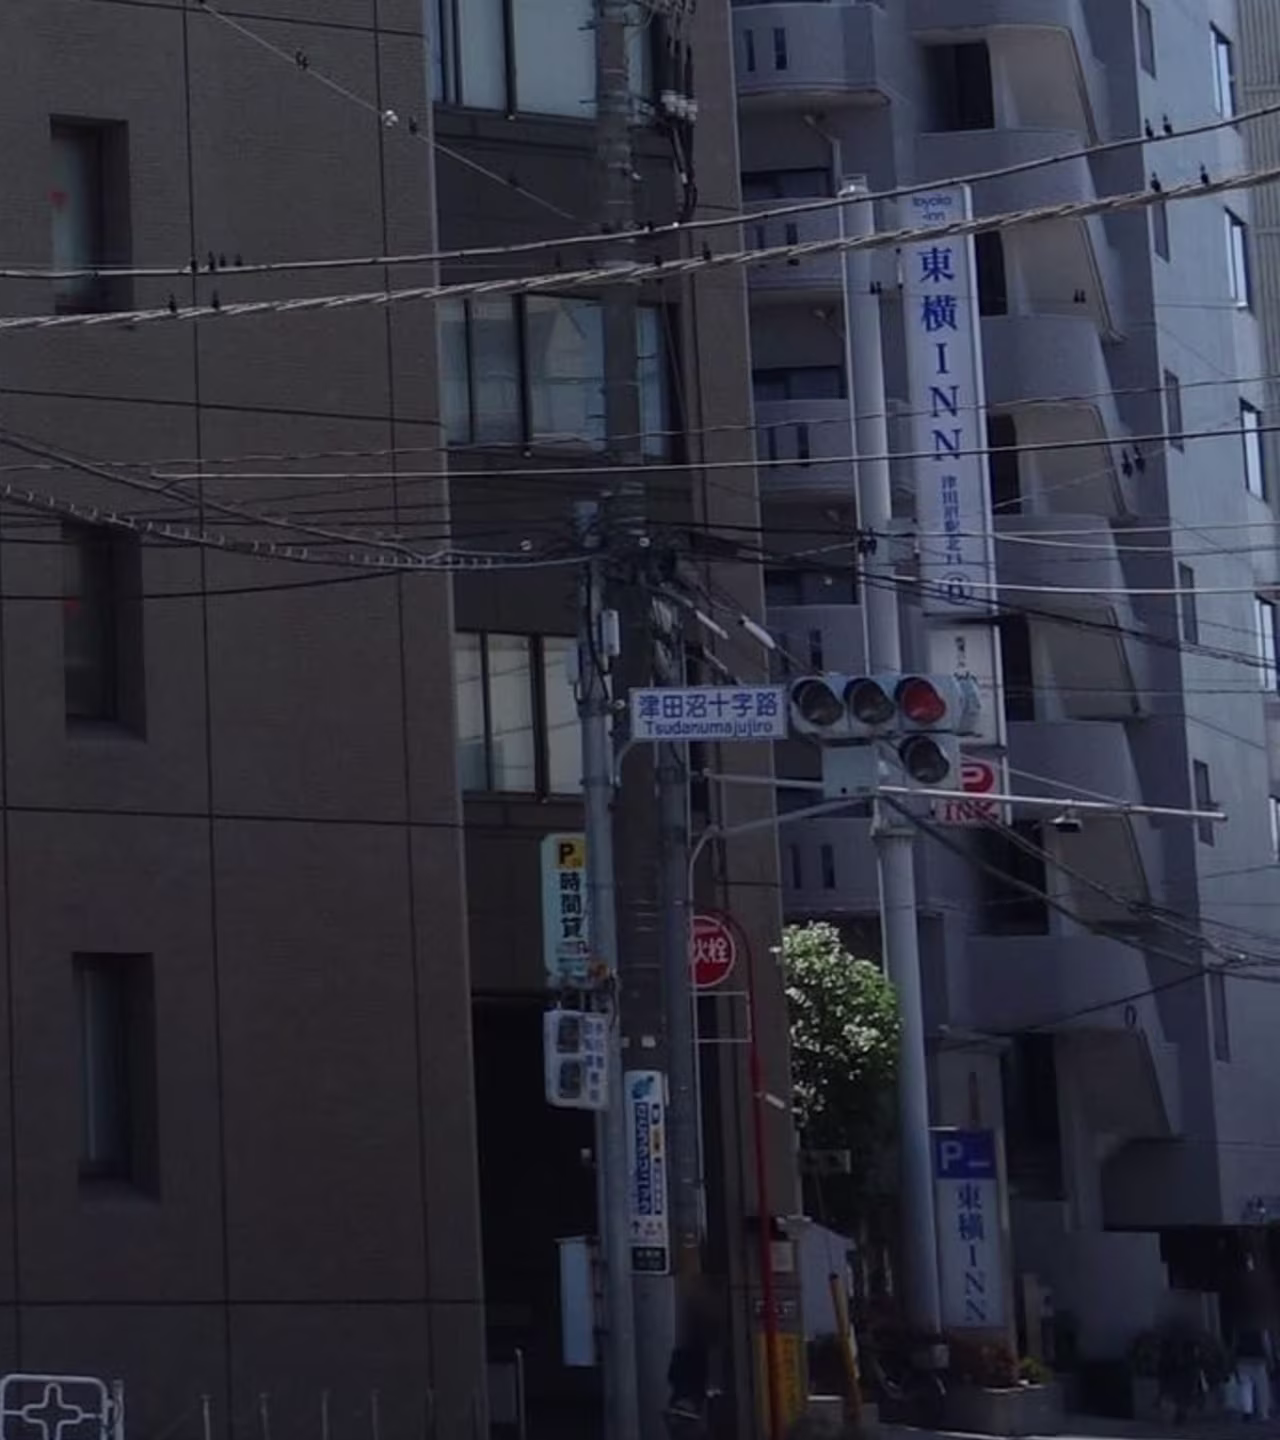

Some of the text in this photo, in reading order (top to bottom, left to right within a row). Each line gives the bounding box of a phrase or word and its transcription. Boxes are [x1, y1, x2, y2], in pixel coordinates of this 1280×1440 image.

[918, 247, 963, 462] 東横INN
[638, 692, 777, 719] 津田沼十字路
[645, 720, 773, 737] Tsudanumajujiro
[560, 872, 583, 939] 時間貸
[693, 937, 729, 963] 火栓
[941, 1140, 963, 1170] P
[956, 1182, 986, 1322] 東横INN
